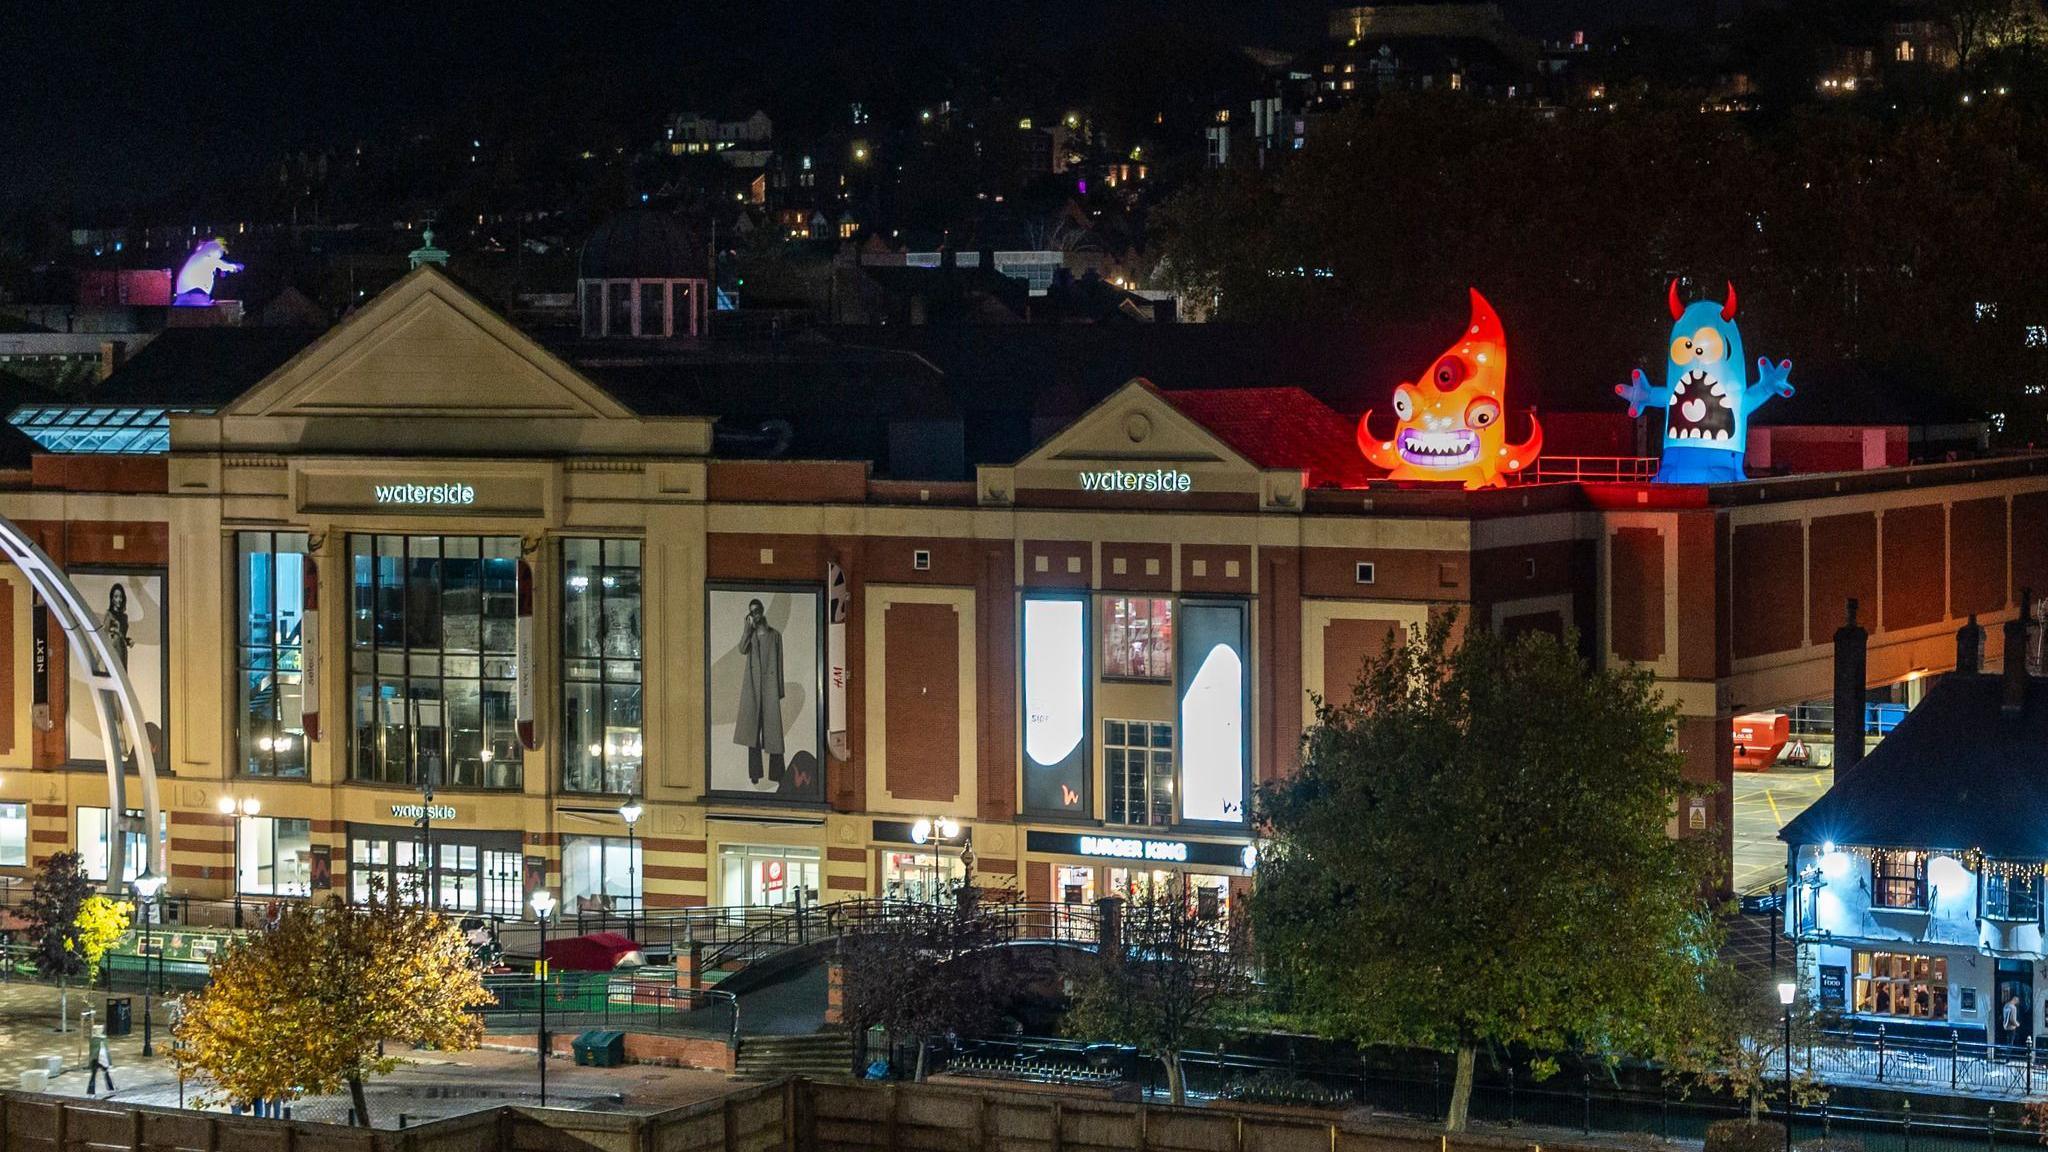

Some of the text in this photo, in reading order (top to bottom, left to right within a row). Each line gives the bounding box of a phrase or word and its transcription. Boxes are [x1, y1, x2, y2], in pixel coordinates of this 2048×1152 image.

[1079, 469, 1191, 492] waterside
[375, 482, 474, 504] waterside
[36, 638, 44, 673] NEXT
[391, 804, 456, 820] wateside
[1080, 836, 1187, 861] BURGER KING
